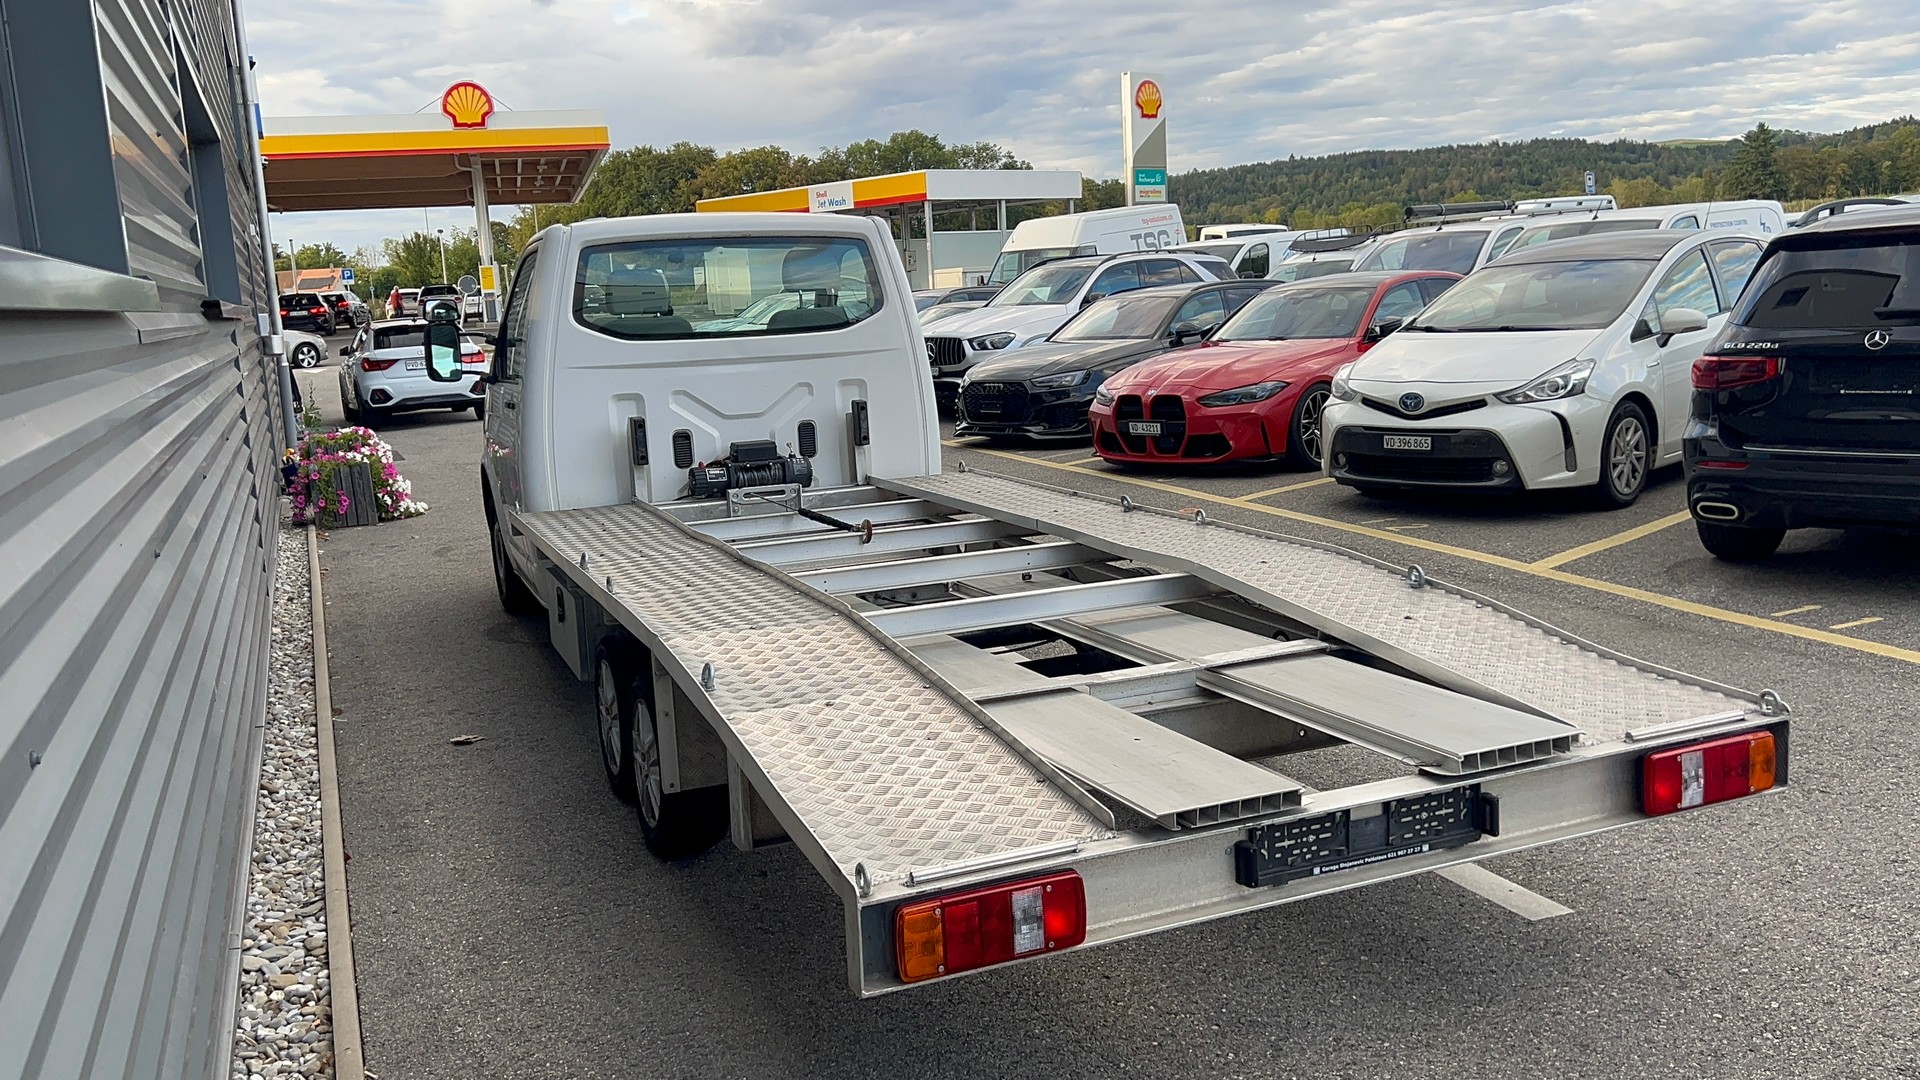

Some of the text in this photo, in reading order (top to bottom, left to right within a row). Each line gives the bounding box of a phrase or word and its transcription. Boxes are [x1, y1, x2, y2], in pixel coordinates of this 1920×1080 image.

[818, 196, 846, 208] Jet Wash
[1130, 230, 1171, 251] TSG
